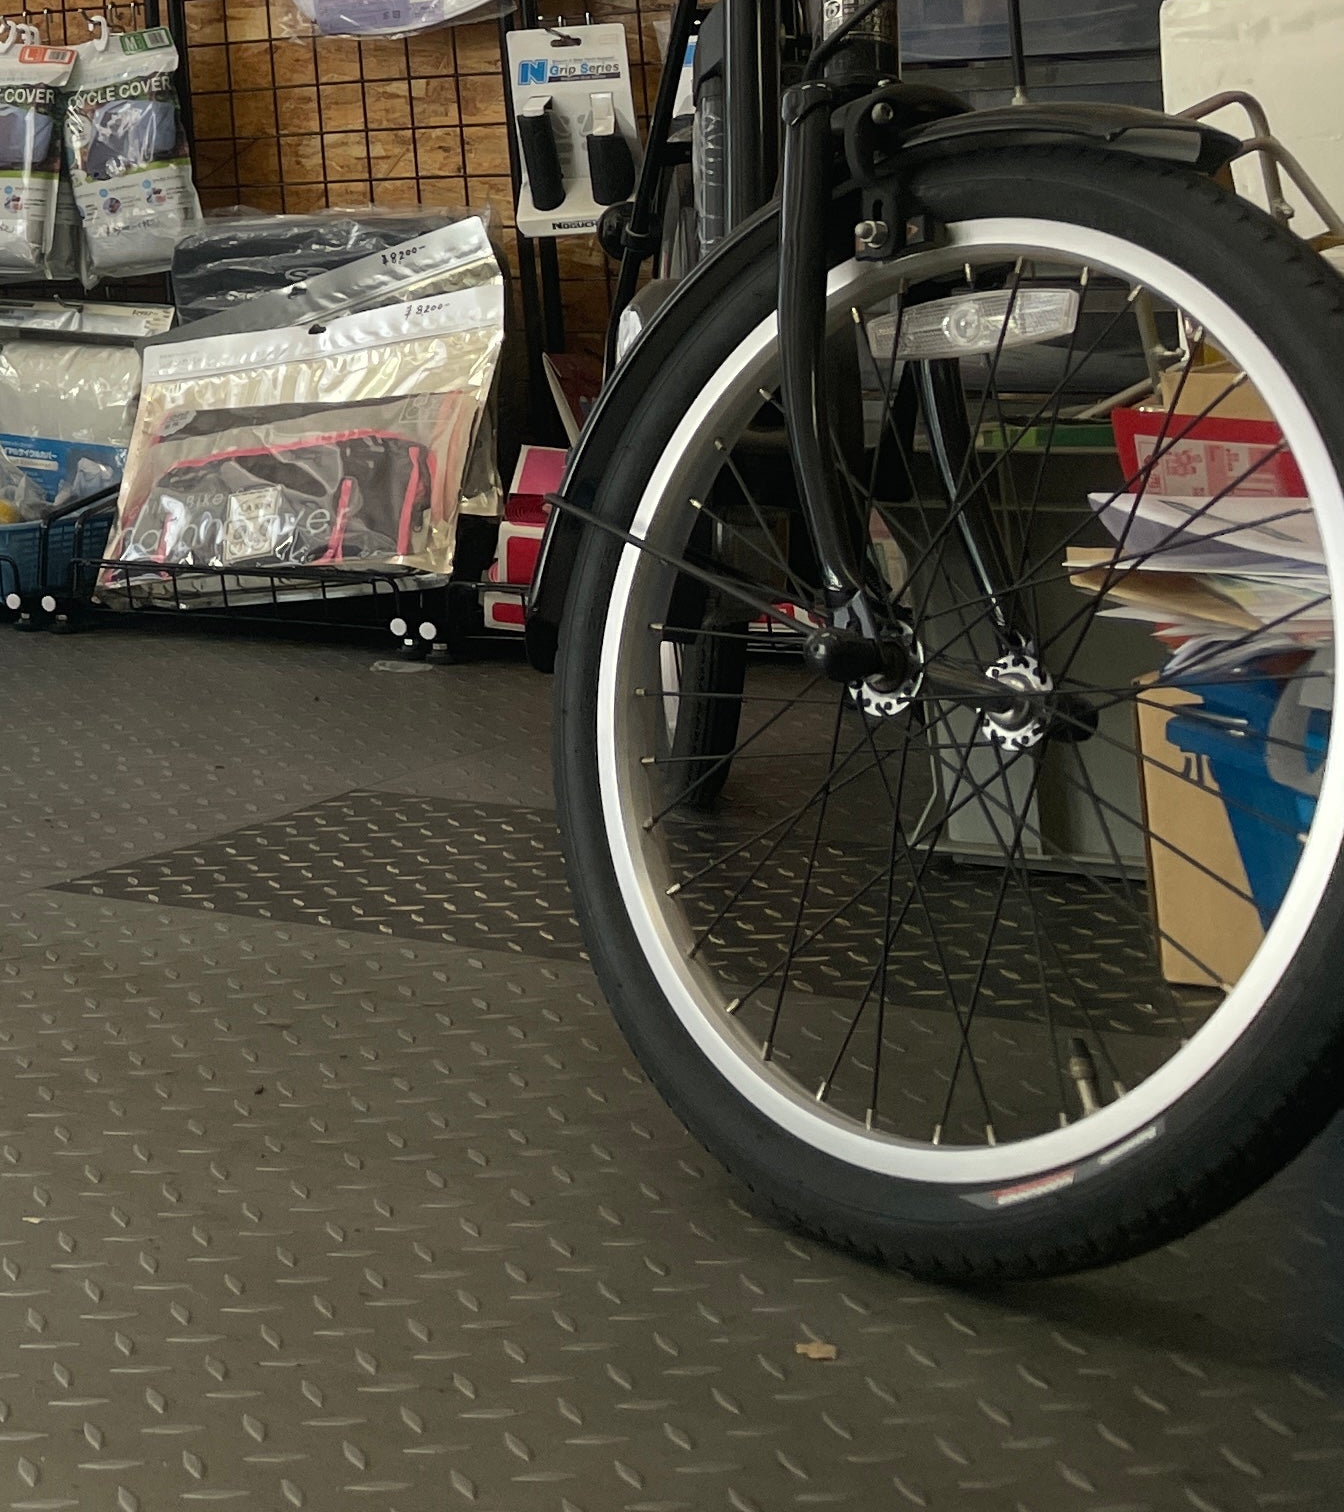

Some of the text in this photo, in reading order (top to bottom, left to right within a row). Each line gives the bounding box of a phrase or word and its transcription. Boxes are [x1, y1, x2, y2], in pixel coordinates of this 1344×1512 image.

[549, 64, 577, 78] Grip
[580, 62, 620, 75] Series
[4, 88, 57, 105] COVER
[118, 76, 174, 100] COVER
